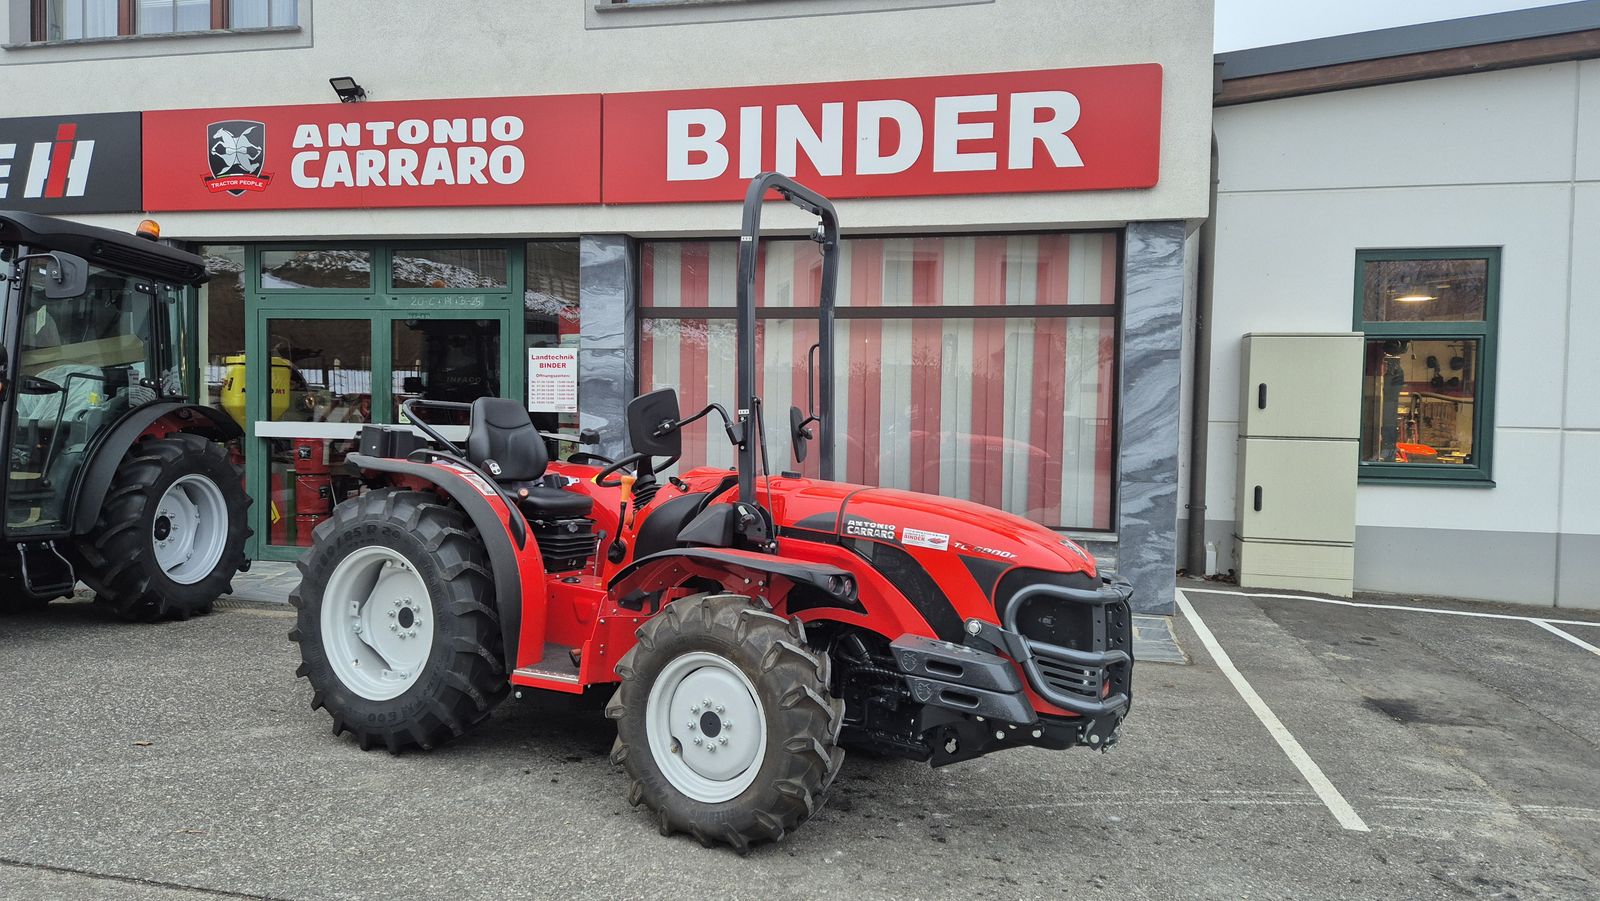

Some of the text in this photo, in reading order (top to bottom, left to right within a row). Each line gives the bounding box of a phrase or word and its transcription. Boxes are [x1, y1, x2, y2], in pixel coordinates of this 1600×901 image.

[293, 115, 524, 148] ANTONIO
[667, 90, 1084, 181] BINDER
[291, 145, 525, 189] CARRARO
[211, 180, 238, 188] TRACTOR
[847, 519, 896, 531] ANTONIO
[847, 526, 896, 540] CARRARO
